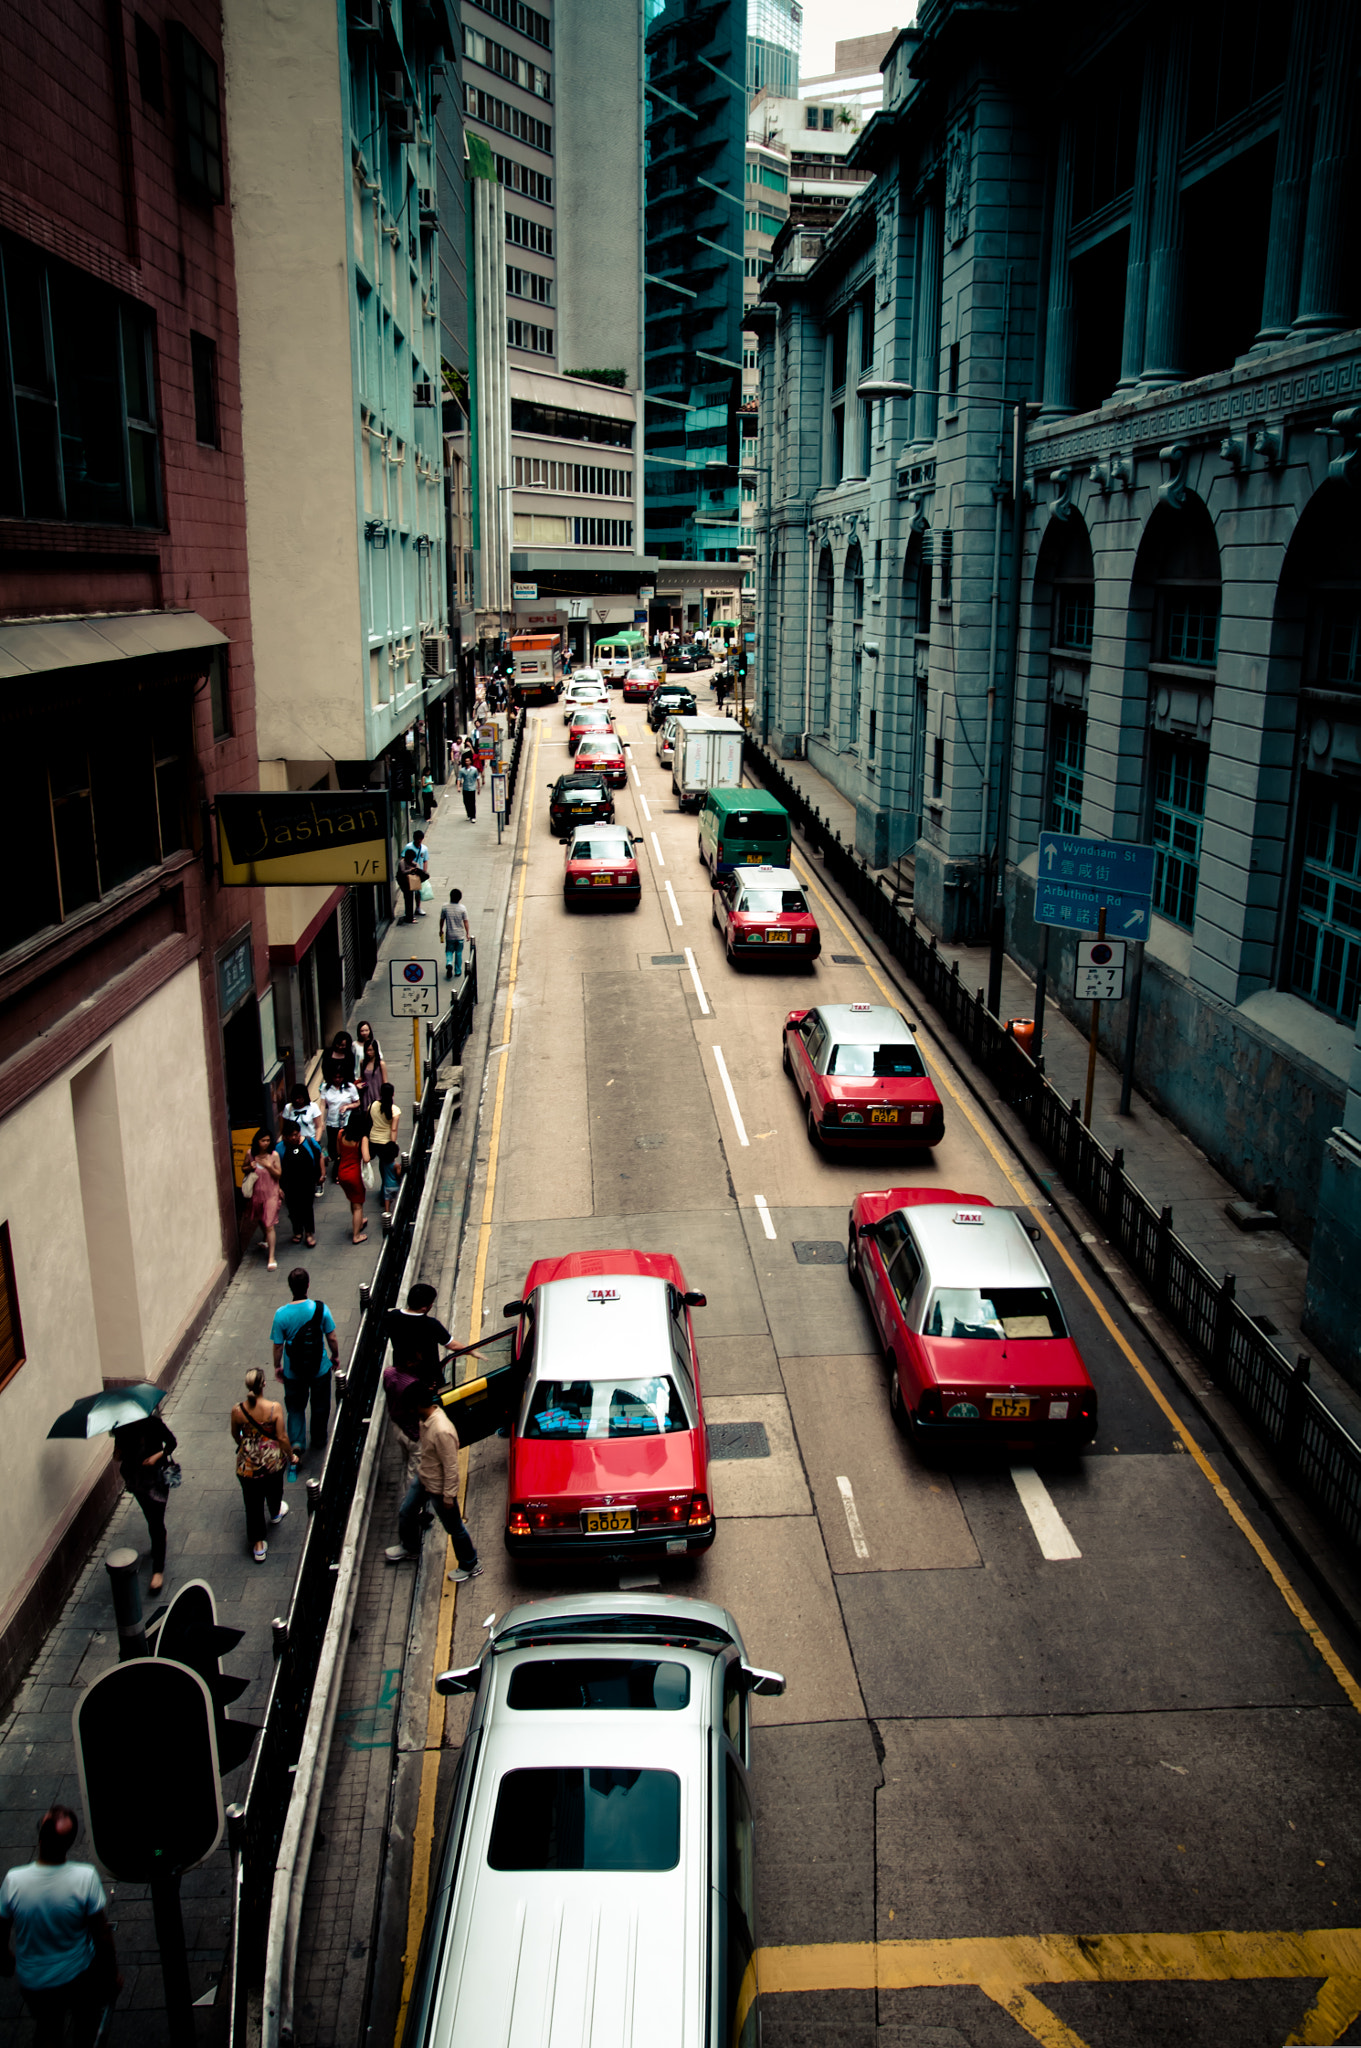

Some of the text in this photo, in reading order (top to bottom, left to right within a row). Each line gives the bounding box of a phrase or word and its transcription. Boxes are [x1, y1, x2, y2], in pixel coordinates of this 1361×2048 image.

[245, 800, 379, 857] Jashan
[1062, 841, 1136, 863] Wyndham St
[354, 859, 379, 876] 1/F
[1043, 885, 1121, 907] Arbuthnot Rd
[1106, 970, 1115, 981] 7
[421, 988, 429, 998] 7
[1106, 986, 1114, 997] 7
[421, 1004, 429, 1013] 7
[591, 1290, 616, 1298] TAXI
[995, 1406, 1027, 1416] 5173
[590, 1519, 629, 1531] 3007
